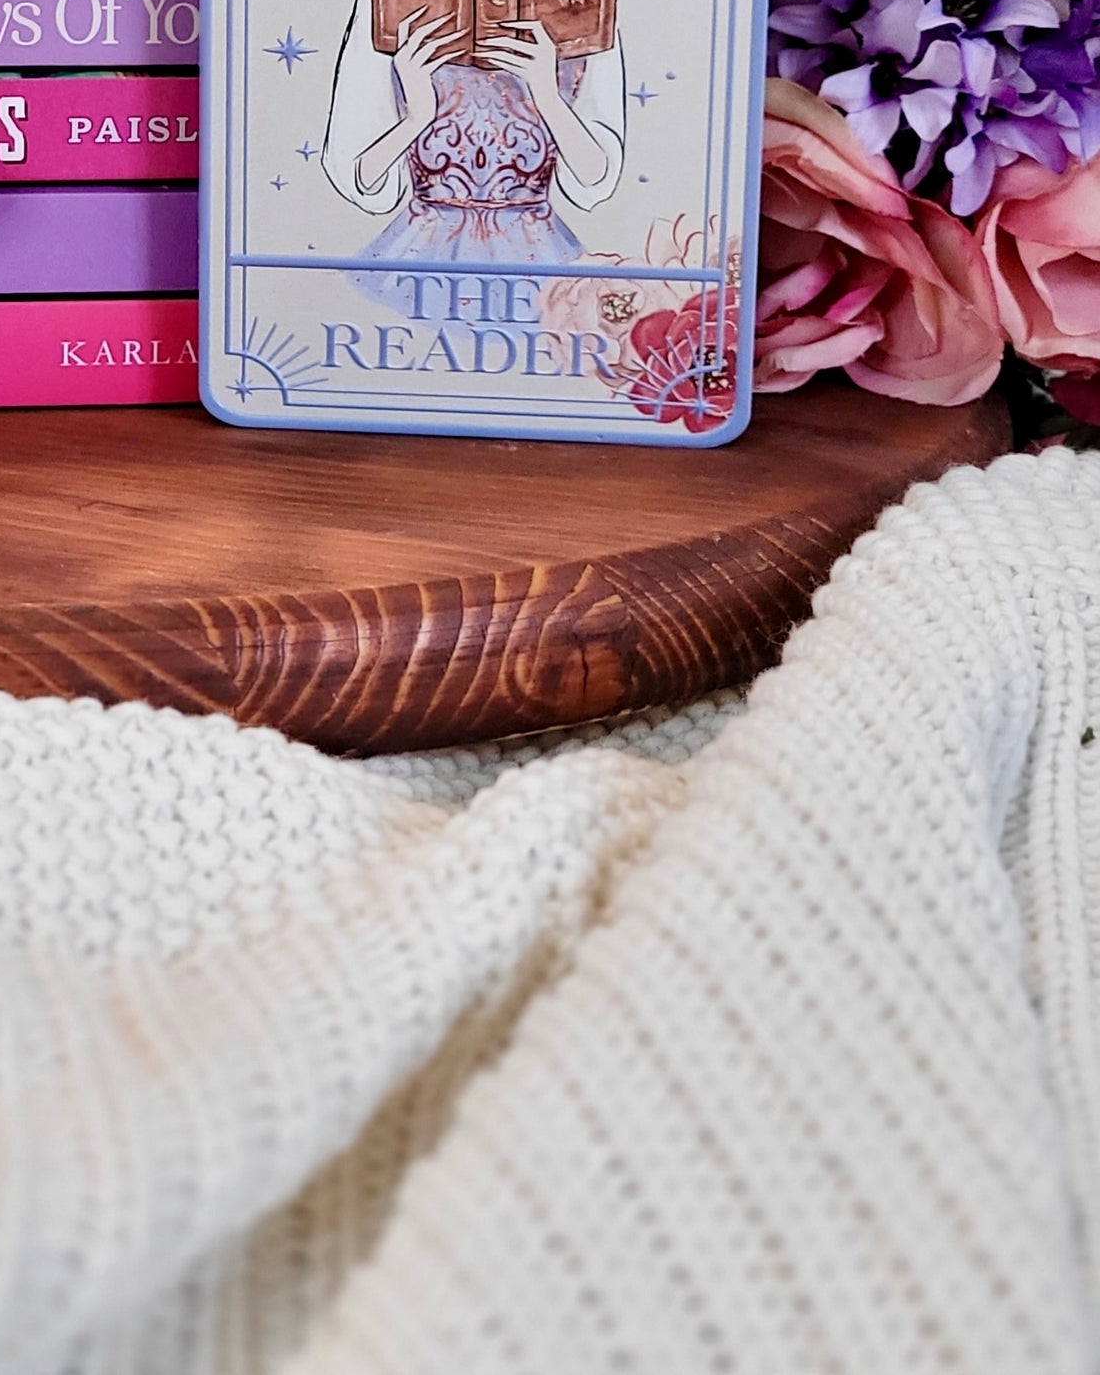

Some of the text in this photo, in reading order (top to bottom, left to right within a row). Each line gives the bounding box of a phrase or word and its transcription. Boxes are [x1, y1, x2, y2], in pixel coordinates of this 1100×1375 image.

[396, 274, 542, 324] THE
[59, 338, 199, 367] KARLA
[319, 322, 619, 380] READER
